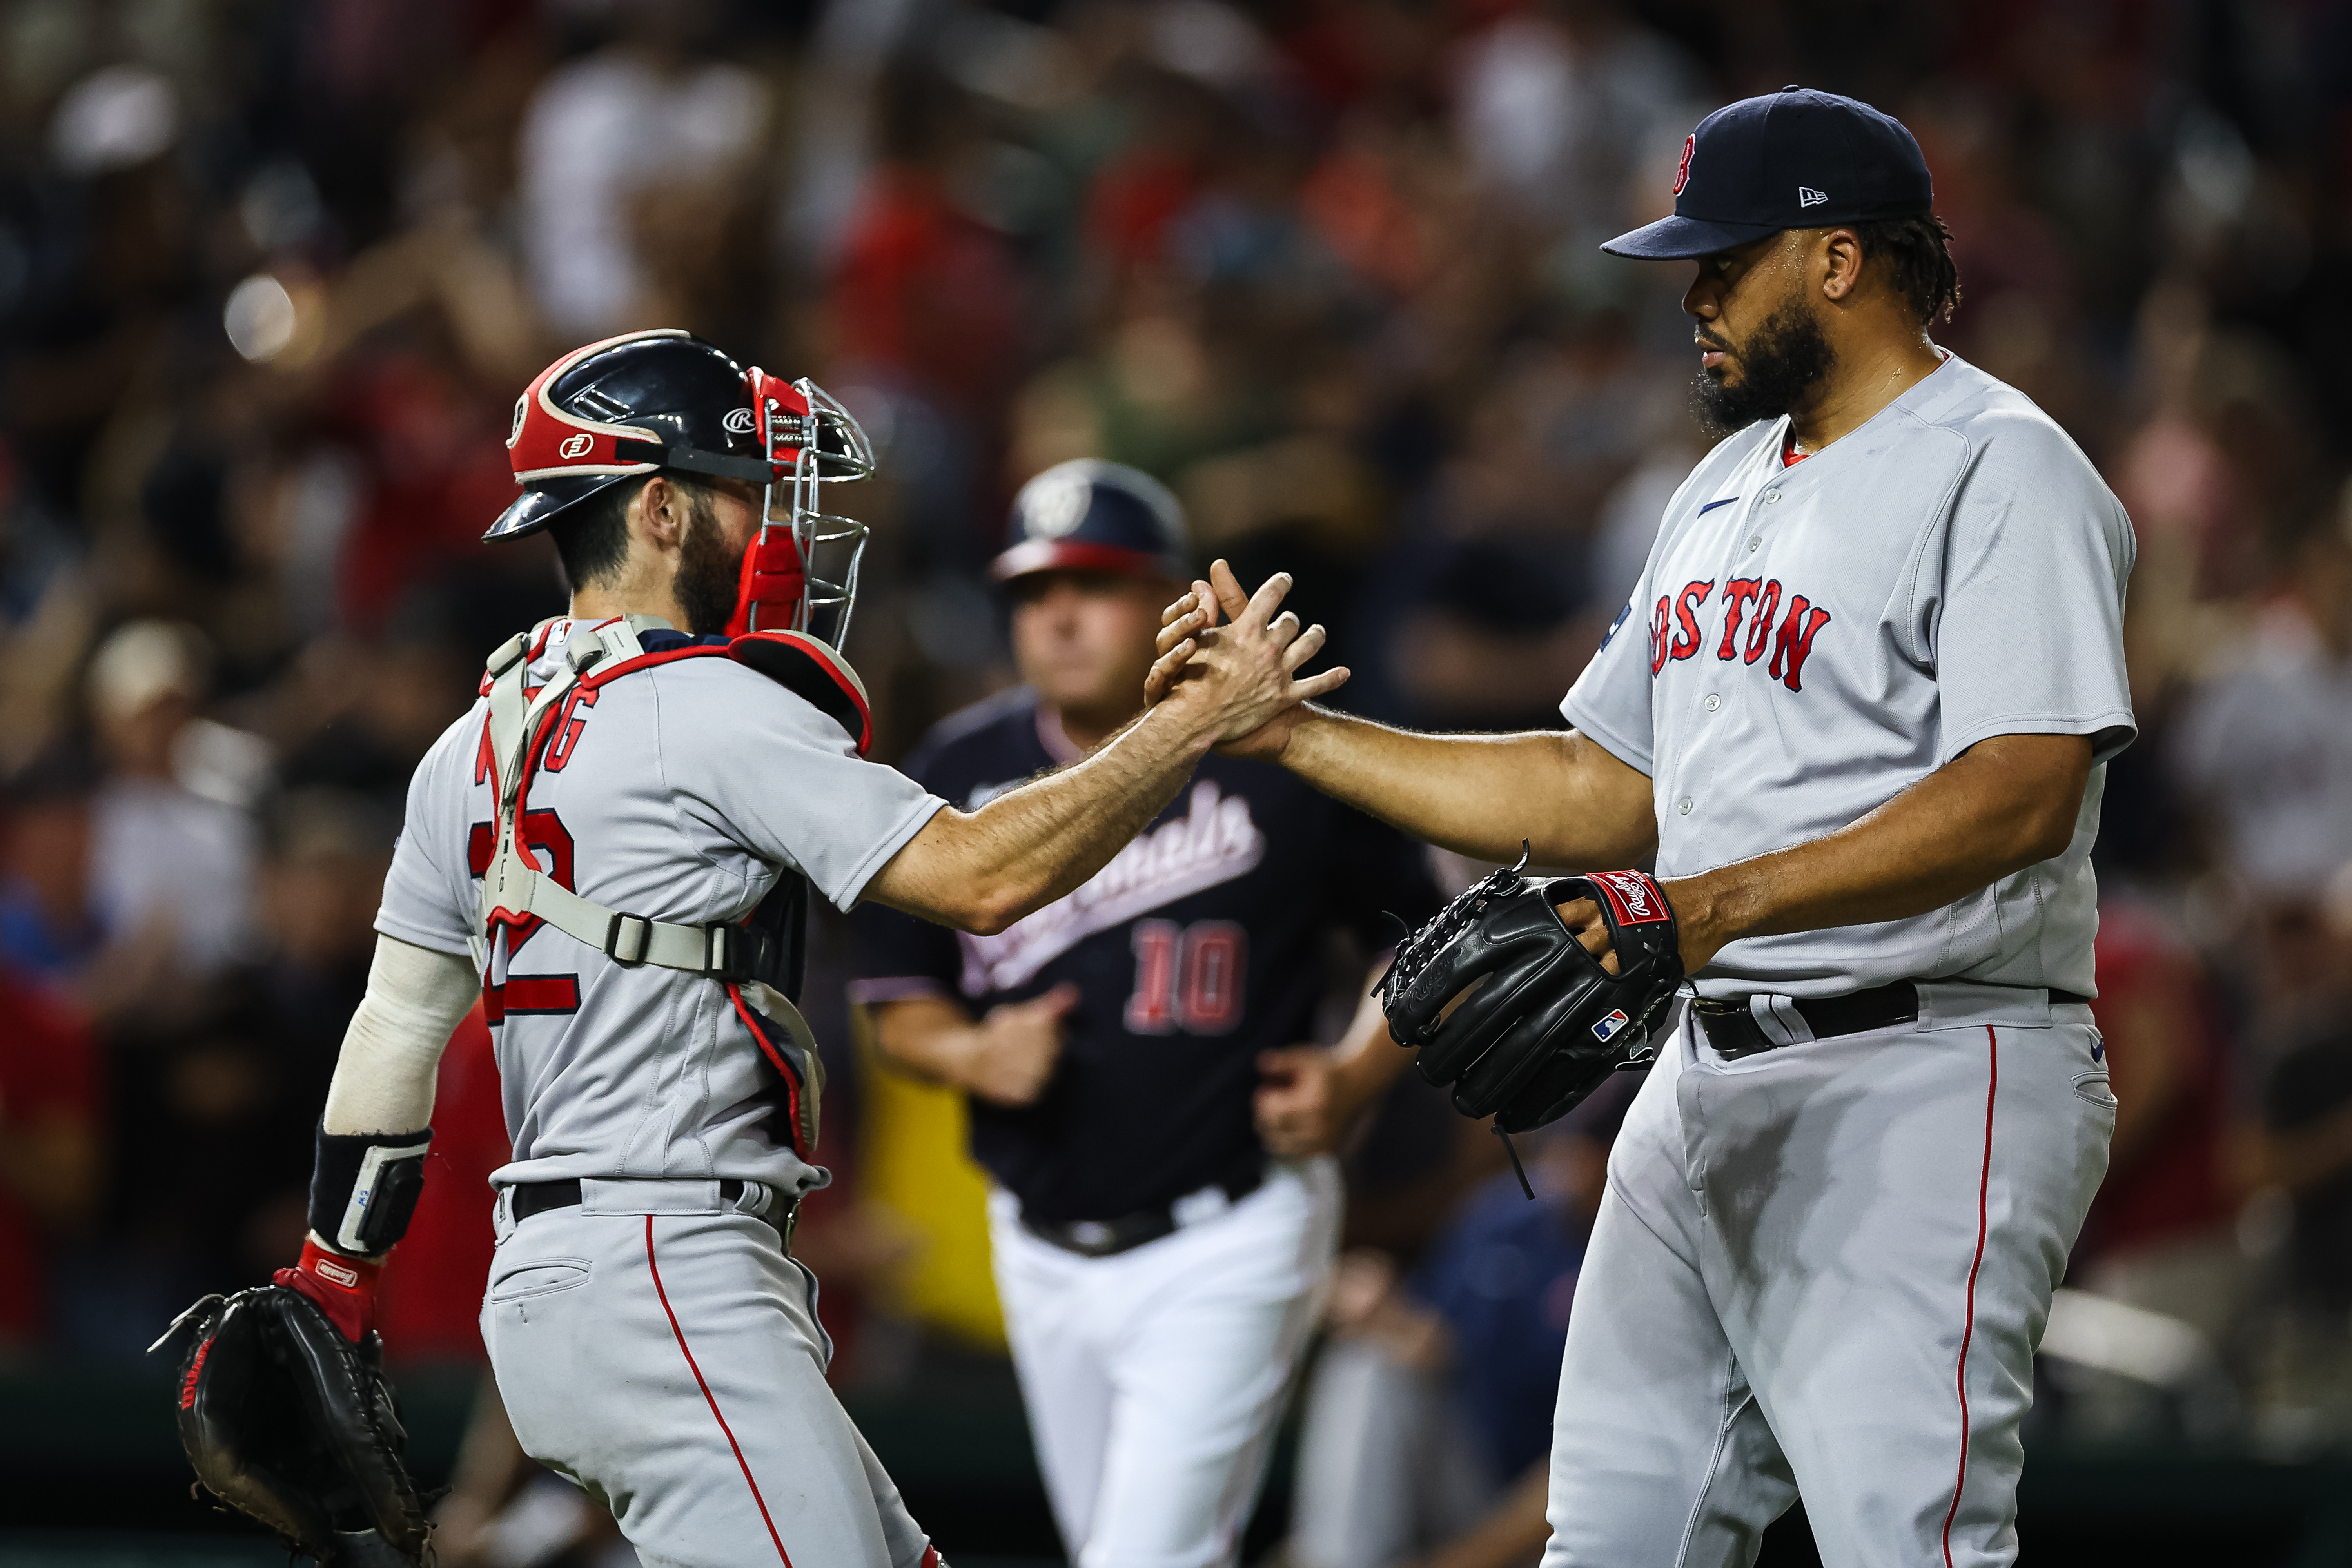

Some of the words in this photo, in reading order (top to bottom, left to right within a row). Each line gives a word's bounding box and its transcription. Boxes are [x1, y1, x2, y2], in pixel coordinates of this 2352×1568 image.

[1648, 576, 1831, 693] OSTON
[1605, 874, 1650, 916] Rawlings
[1123, 918, 1249, 1037] 10
